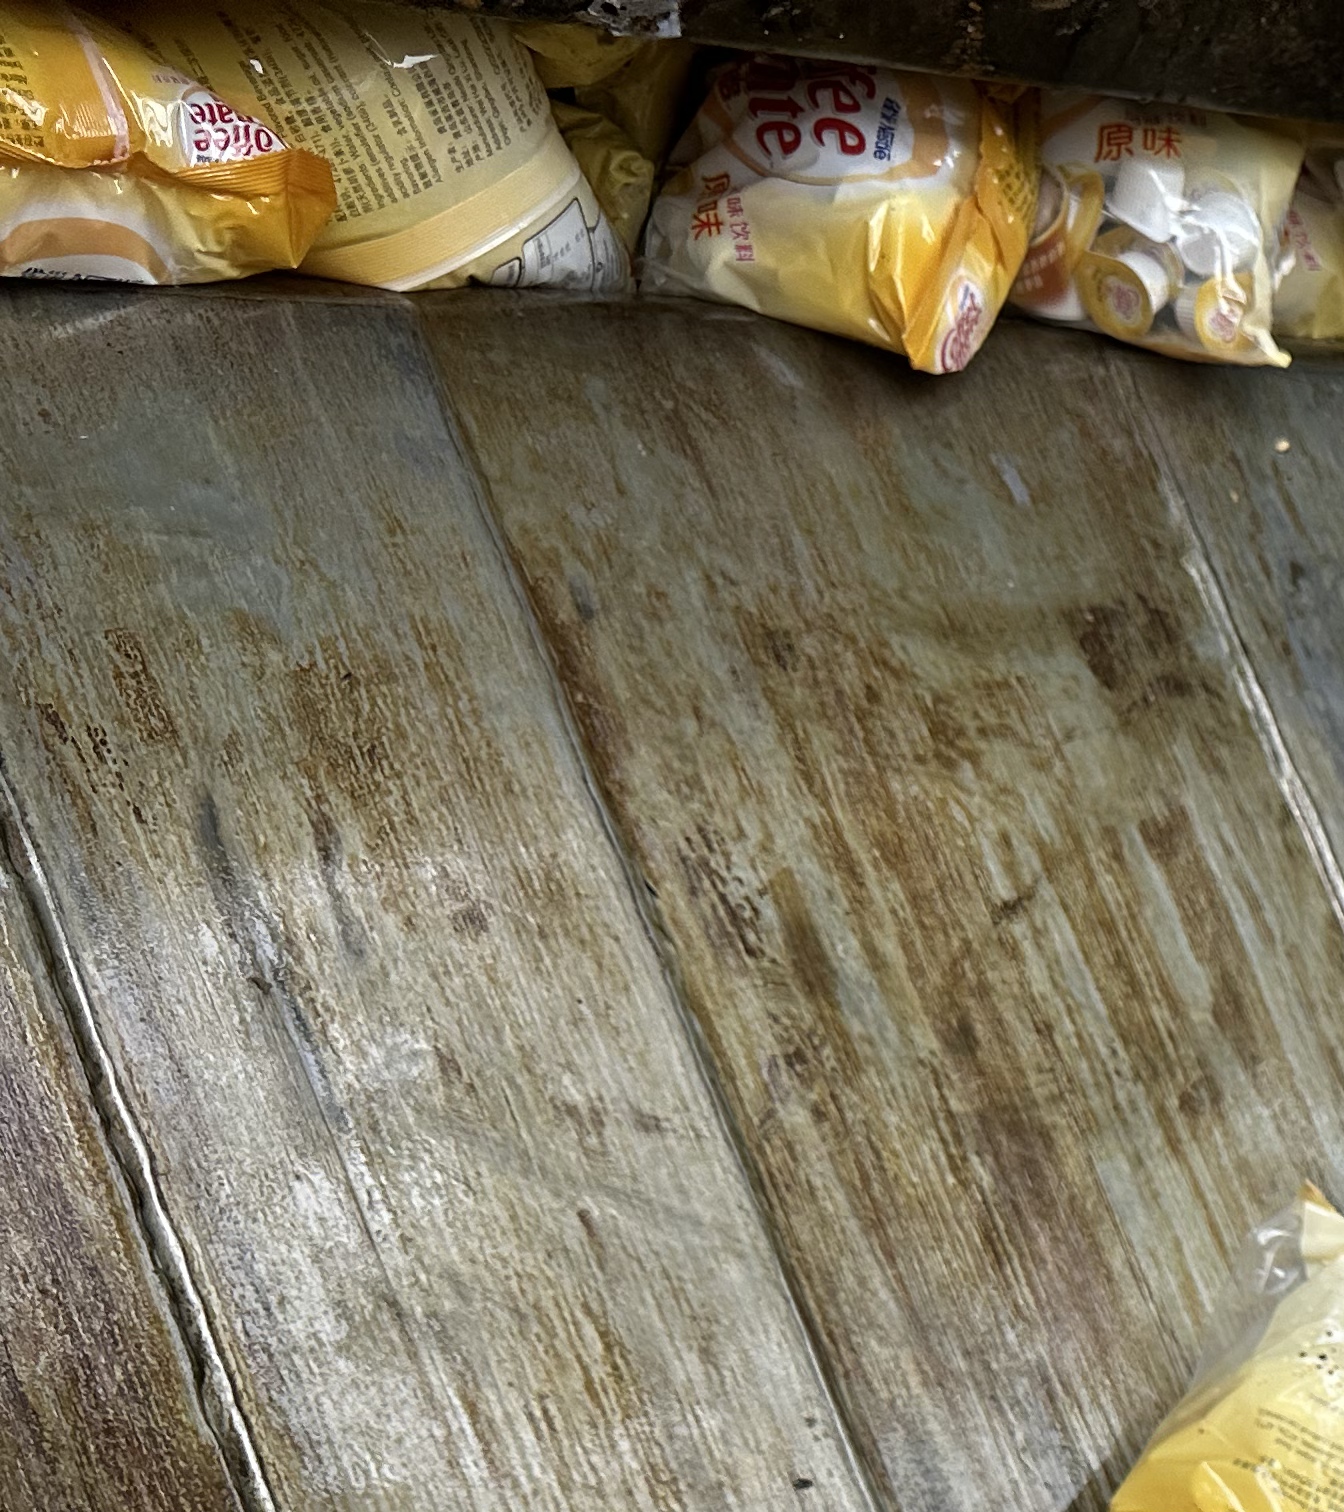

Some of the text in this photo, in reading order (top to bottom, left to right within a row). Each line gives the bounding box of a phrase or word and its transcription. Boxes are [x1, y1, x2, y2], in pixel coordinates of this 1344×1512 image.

[194, 125, 273, 157] offee
[1094, 122, 1184, 163] 原味
[726, 197, 755, 262] 味饮料
